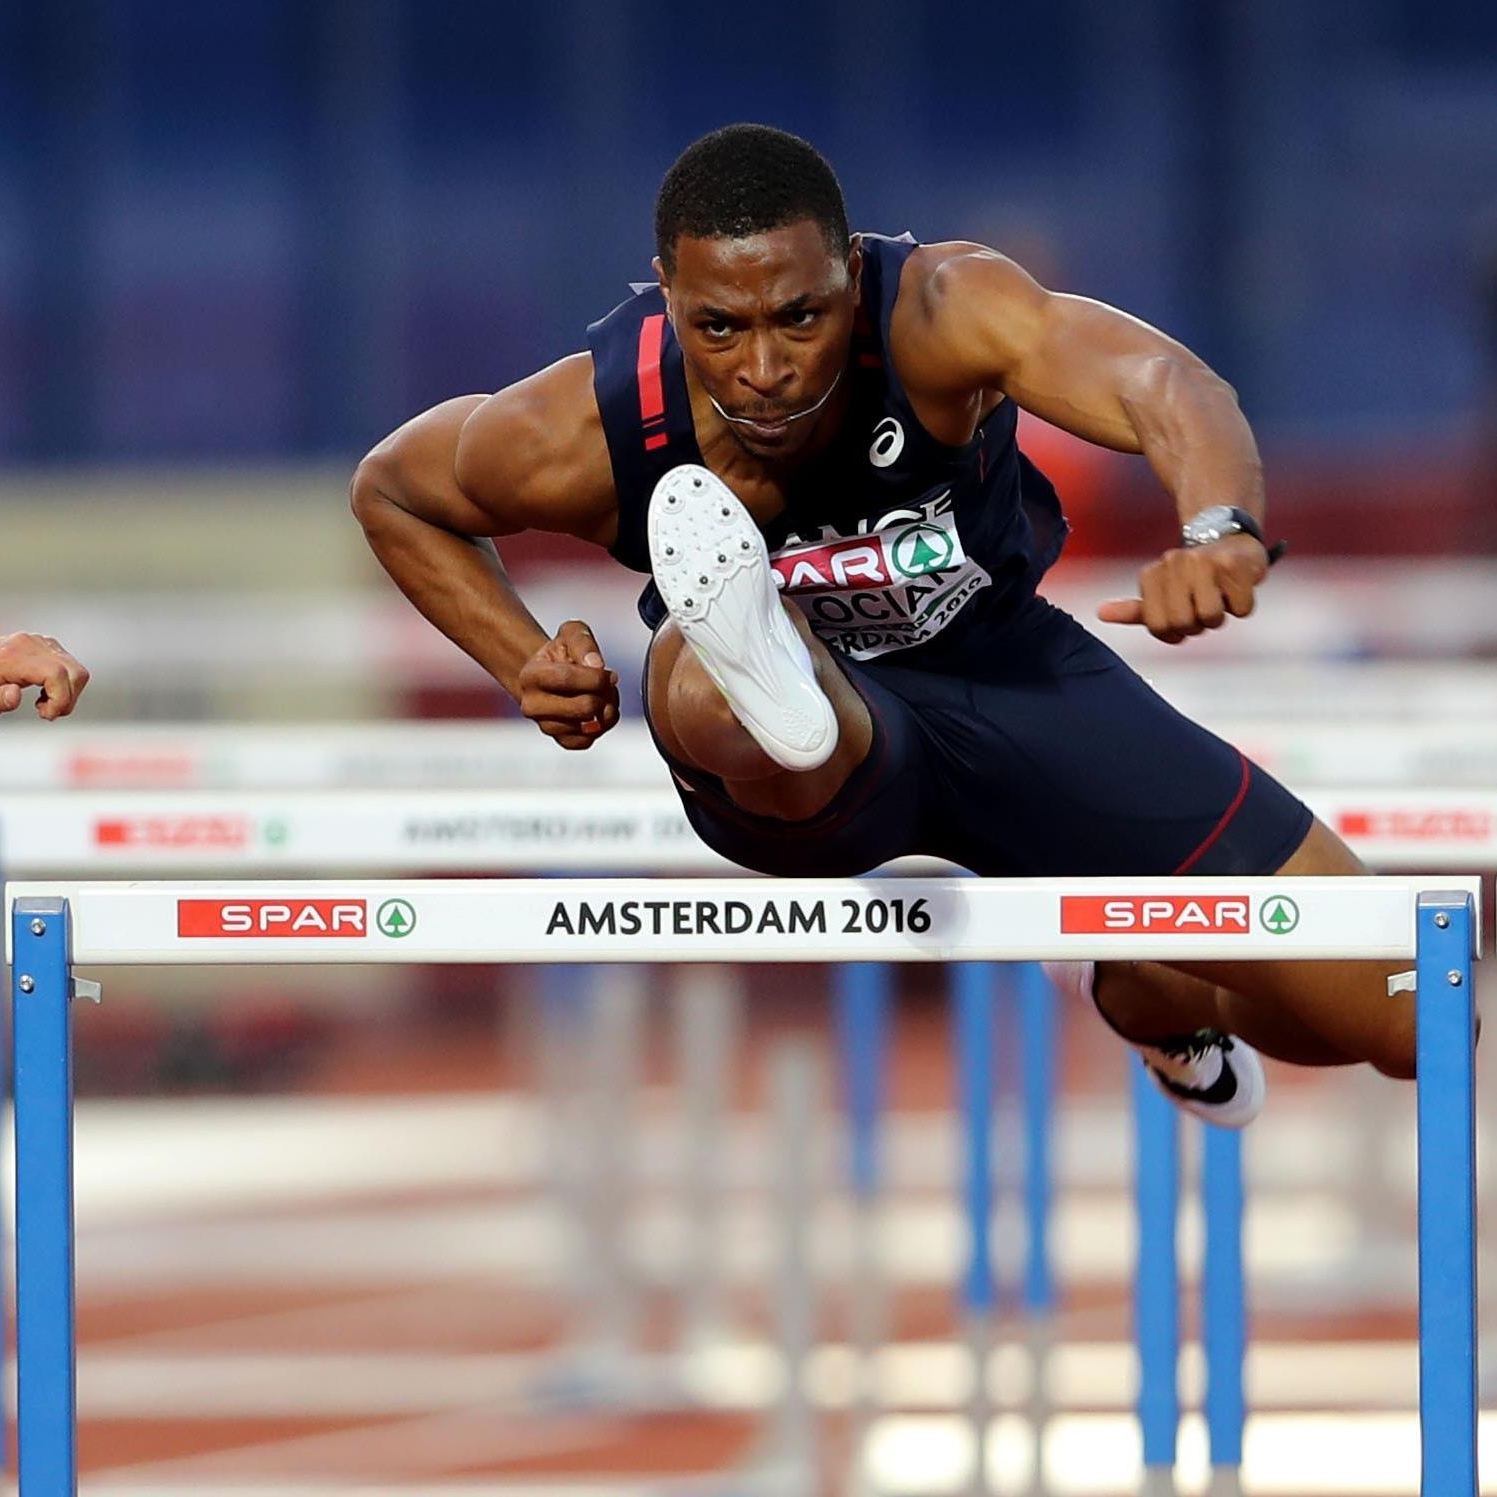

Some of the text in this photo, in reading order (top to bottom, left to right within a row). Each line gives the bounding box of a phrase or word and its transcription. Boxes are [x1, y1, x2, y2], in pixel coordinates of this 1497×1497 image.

[220, 903, 365, 932] SPAR
[545, 898, 932, 936] AMSTERDAM 2016
[1102, 901, 1249, 929] SPAR
